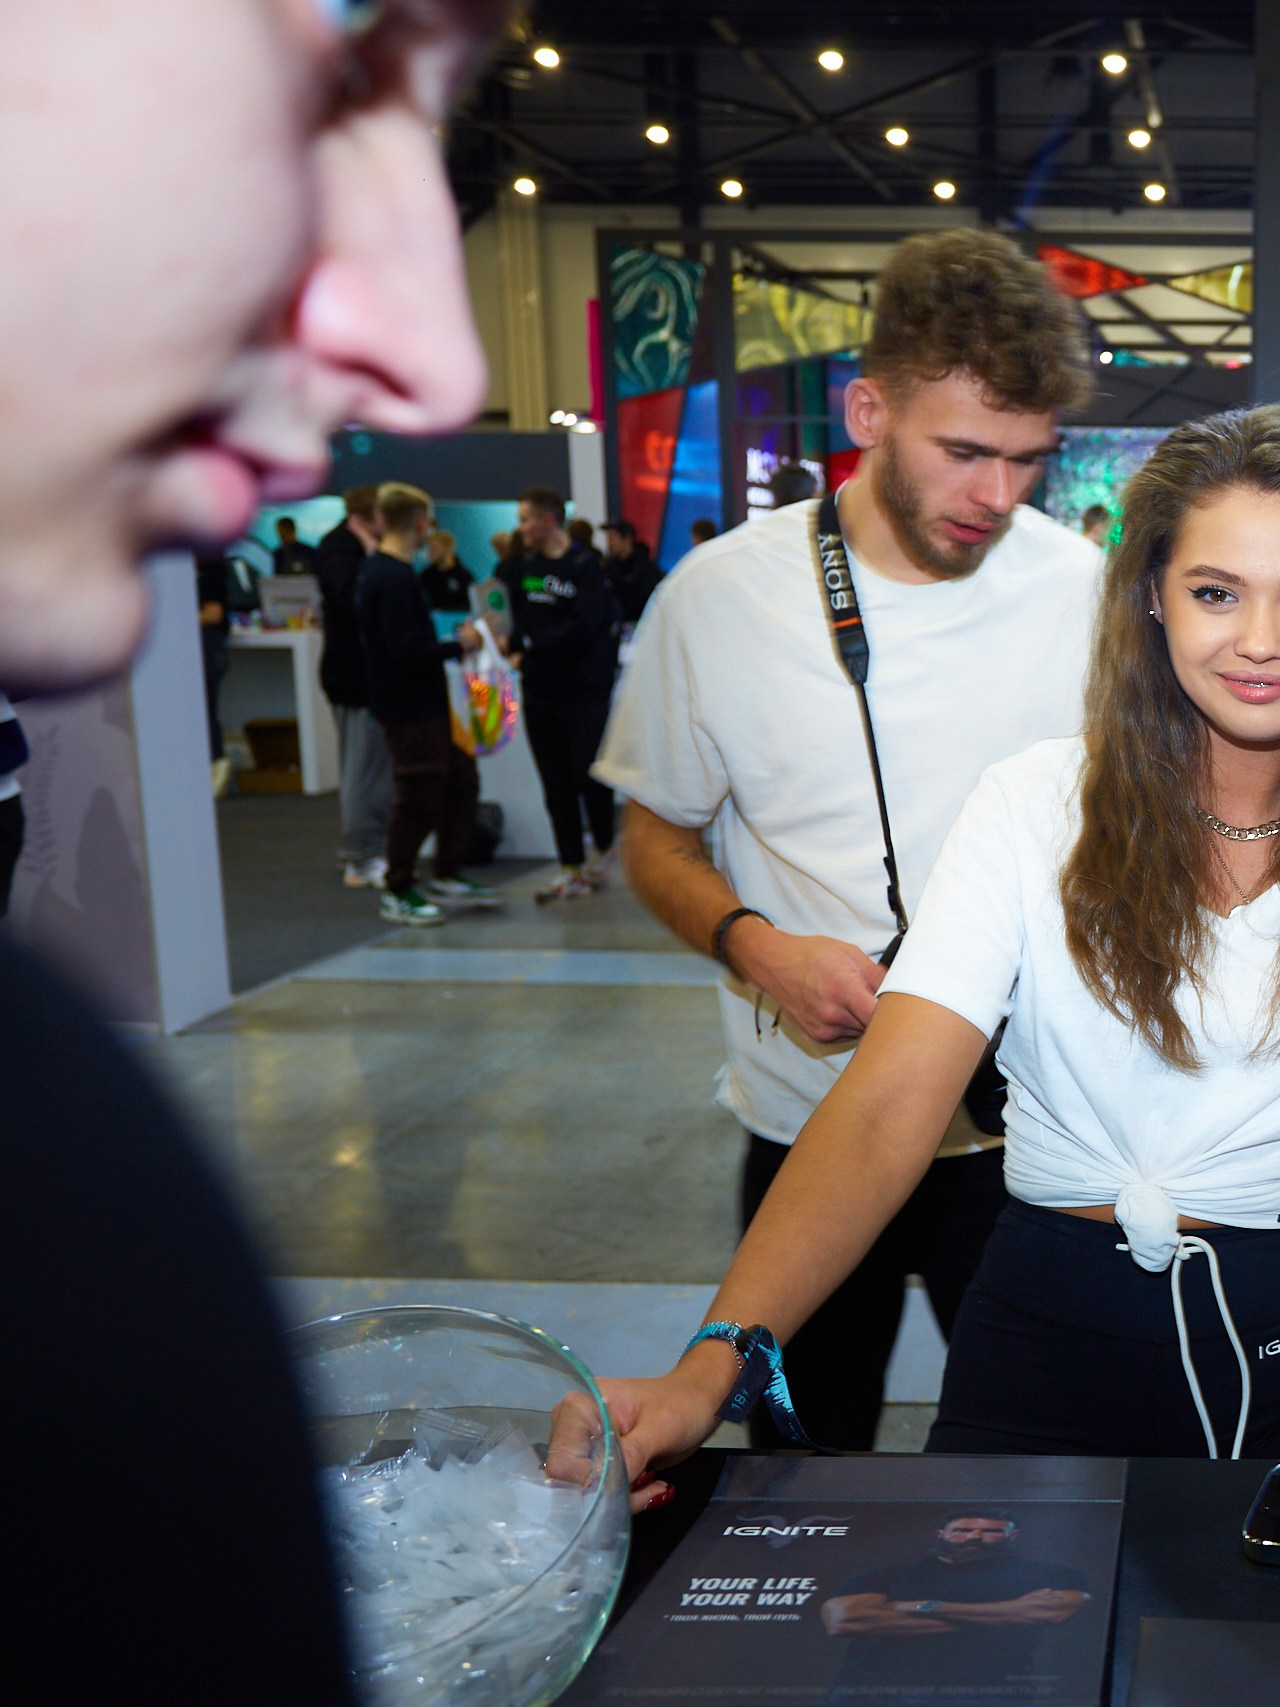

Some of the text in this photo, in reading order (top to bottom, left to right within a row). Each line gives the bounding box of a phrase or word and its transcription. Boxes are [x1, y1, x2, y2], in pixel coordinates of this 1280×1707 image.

[817, 534, 848, 610] SONY
[731, 1388, 750, 1409] 18+
[723, 1526, 849, 1536] IGNITE
[689, 1577, 758, 1590] YOUR
[680, 1593, 812, 1606] YOUR WAY
